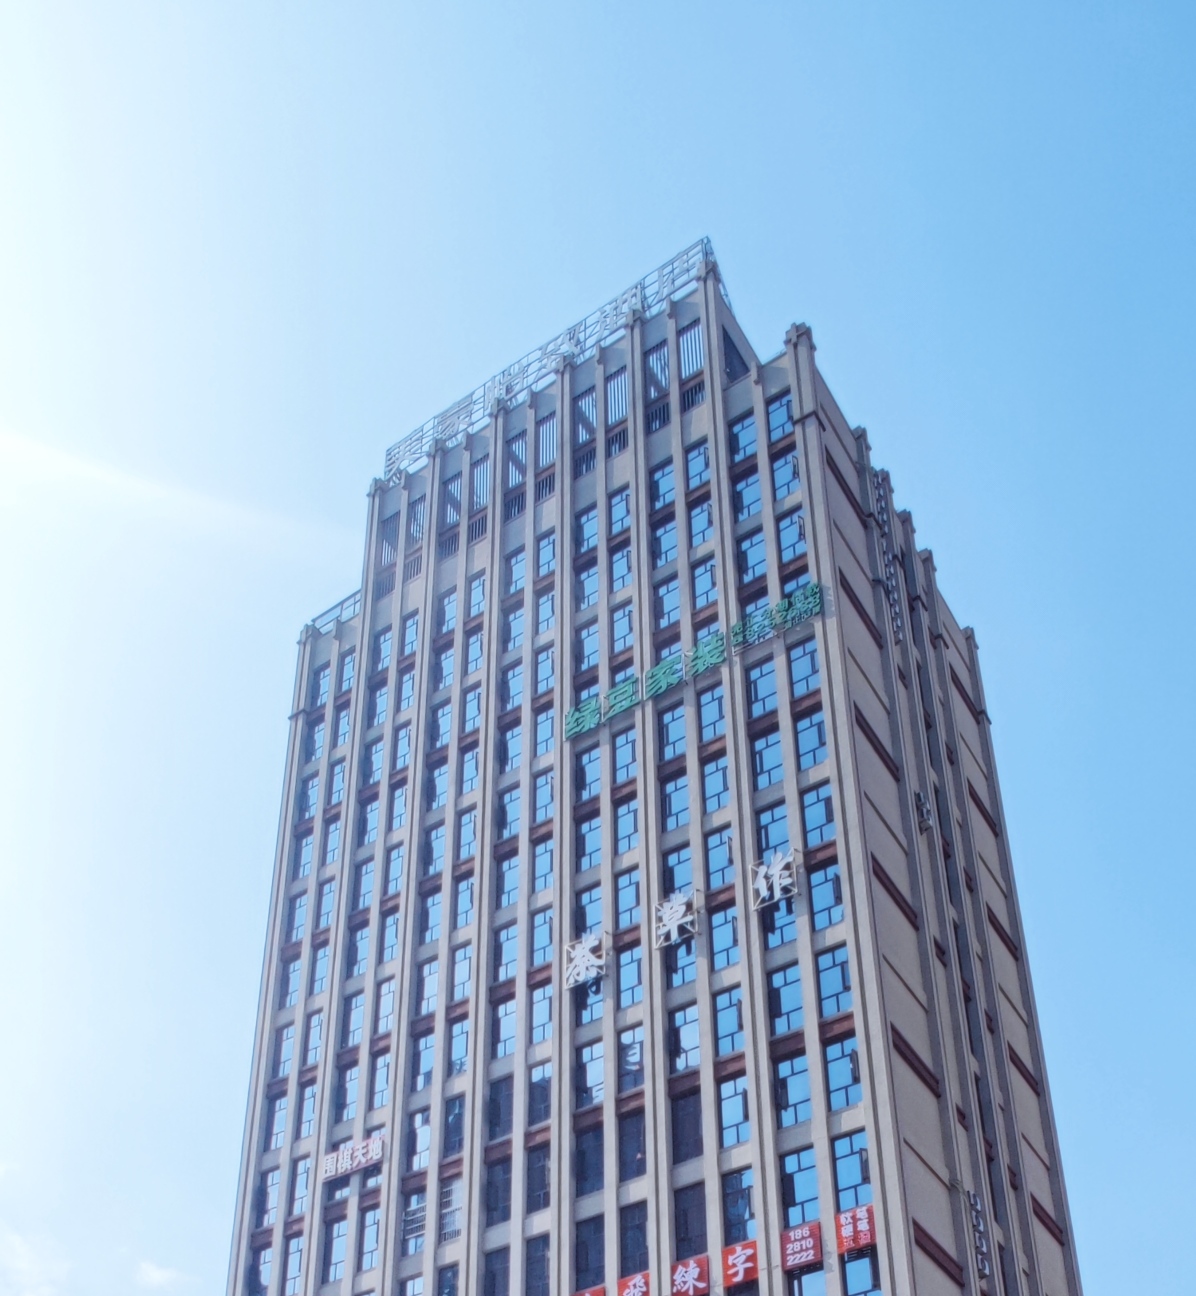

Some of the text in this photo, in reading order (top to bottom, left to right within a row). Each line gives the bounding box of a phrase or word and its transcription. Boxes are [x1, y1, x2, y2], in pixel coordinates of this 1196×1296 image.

[788, 1227, 810, 1241] 186
[786, 1237, 814, 1255] 2810
[786, 1249, 815, 1266] 2222
